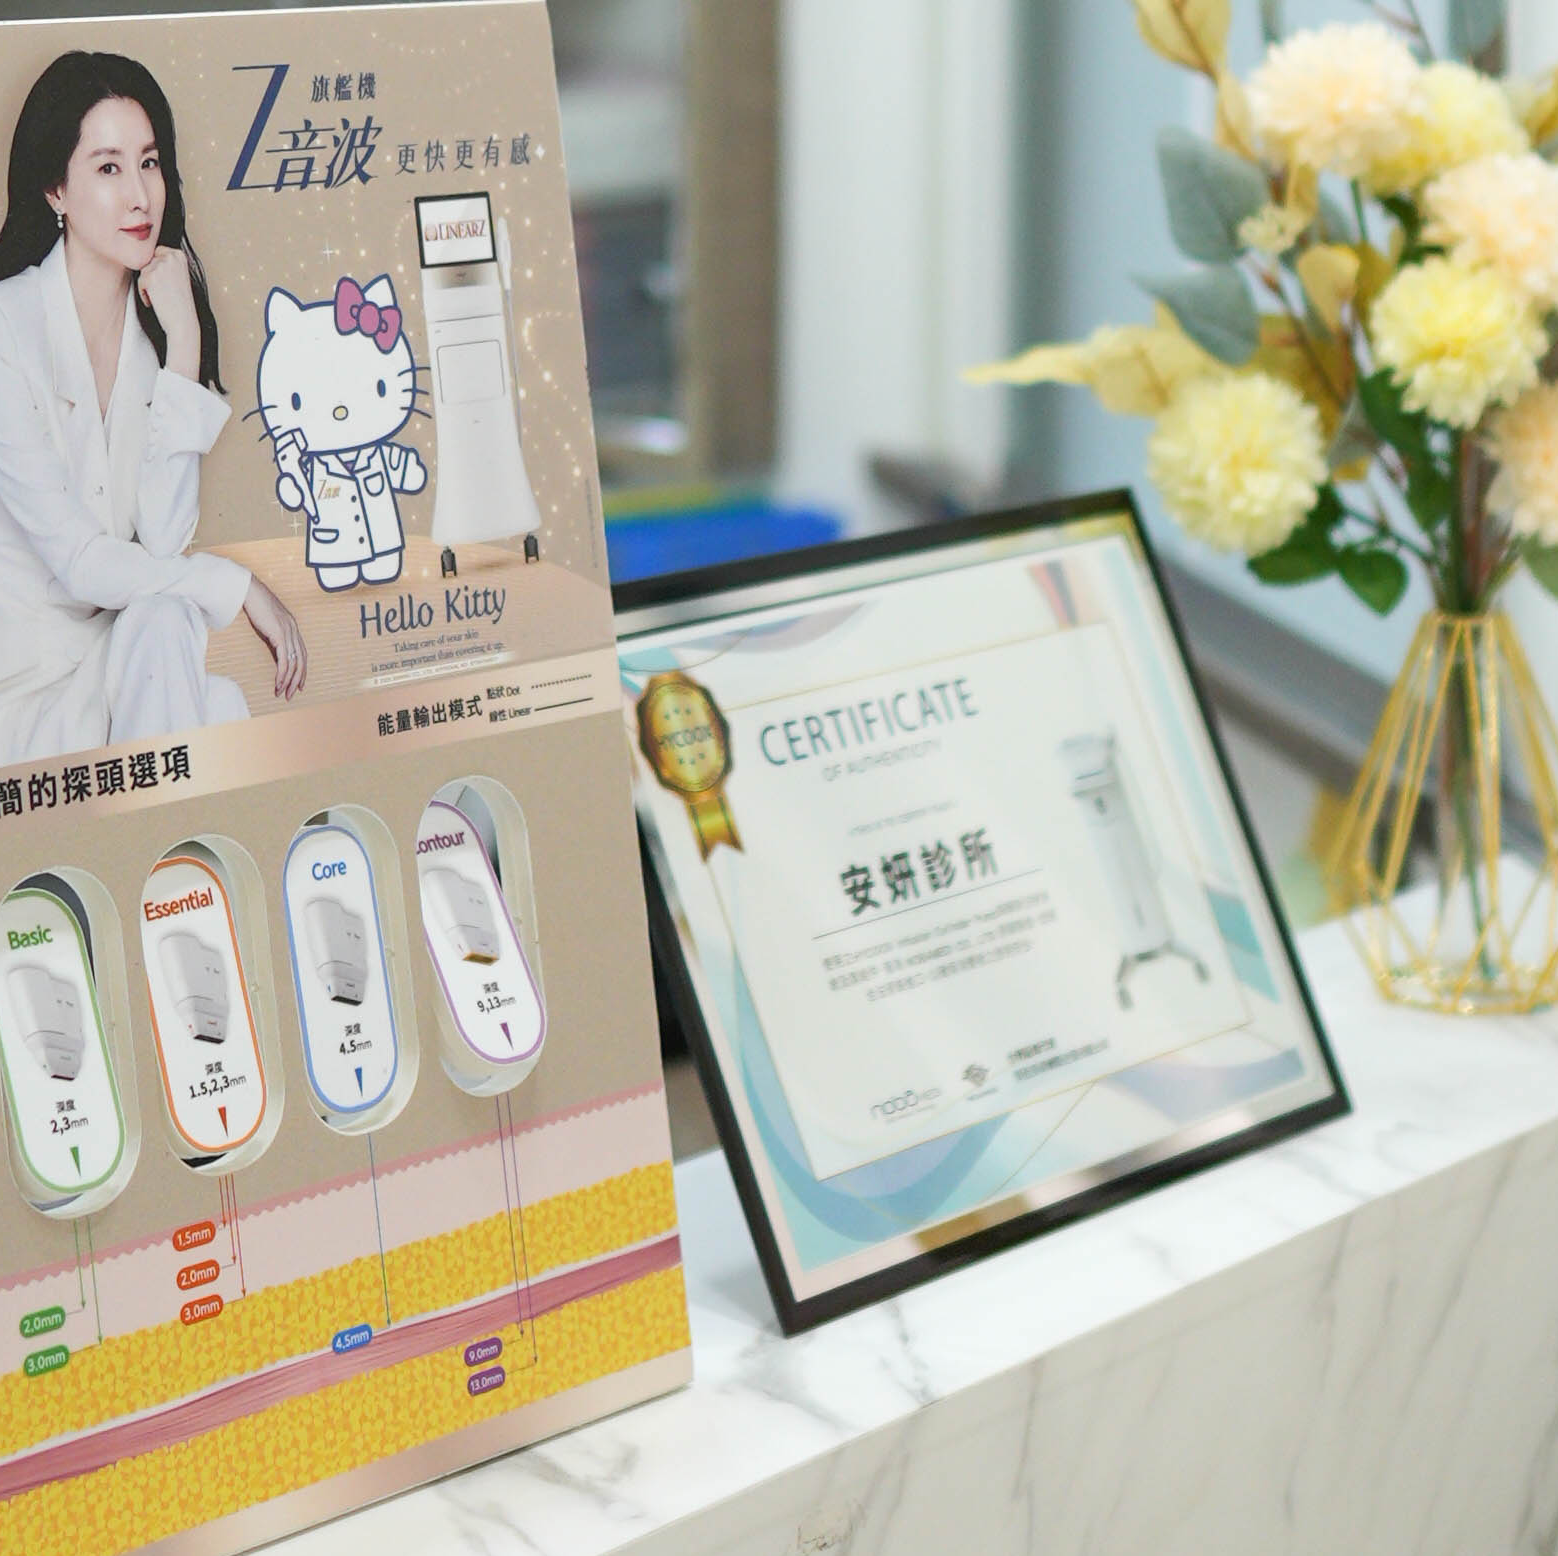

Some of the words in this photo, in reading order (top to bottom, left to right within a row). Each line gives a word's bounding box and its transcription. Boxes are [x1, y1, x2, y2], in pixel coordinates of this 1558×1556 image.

[310, 72, 376, 103] 旗艦機
[395, 132, 531, 176] 更快更有感
[360, 594, 433, 638] Hello
[445, 585, 505, 624] Kitty
[377, 694, 483, 737] 能量輸出模式
[759, 677, 980, 766] CERTIFICATE
[312, 860, 347, 881] Core
[839, 826, 999, 916] 安妍診所
[144, 887, 214, 922] Essential
[7, 924, 53, 951] Basic
[339, 1039, 373, 1056] 4.5mm
[205, 1061, 224, 1075] 深度
[56, 1099, 75, 1114] 深度
[50, 1116, 89, 1136] 2,3mm
[177, 1226, 213, 1246] 1.5mm
[180, 1265, 217, 1286] 2.0mm
[184, 1299, 221, 1322] 3.0mm
[22, 1312, 62, 1334] 2.0mm
[335, 1328, 370, 1349] 4.5mm
[26, 1350, 67, 1373] 3.0mm
[468, 1344, 499, 1362] 9.0mm
[470, 1371, 504, 1395] 13.0mm
